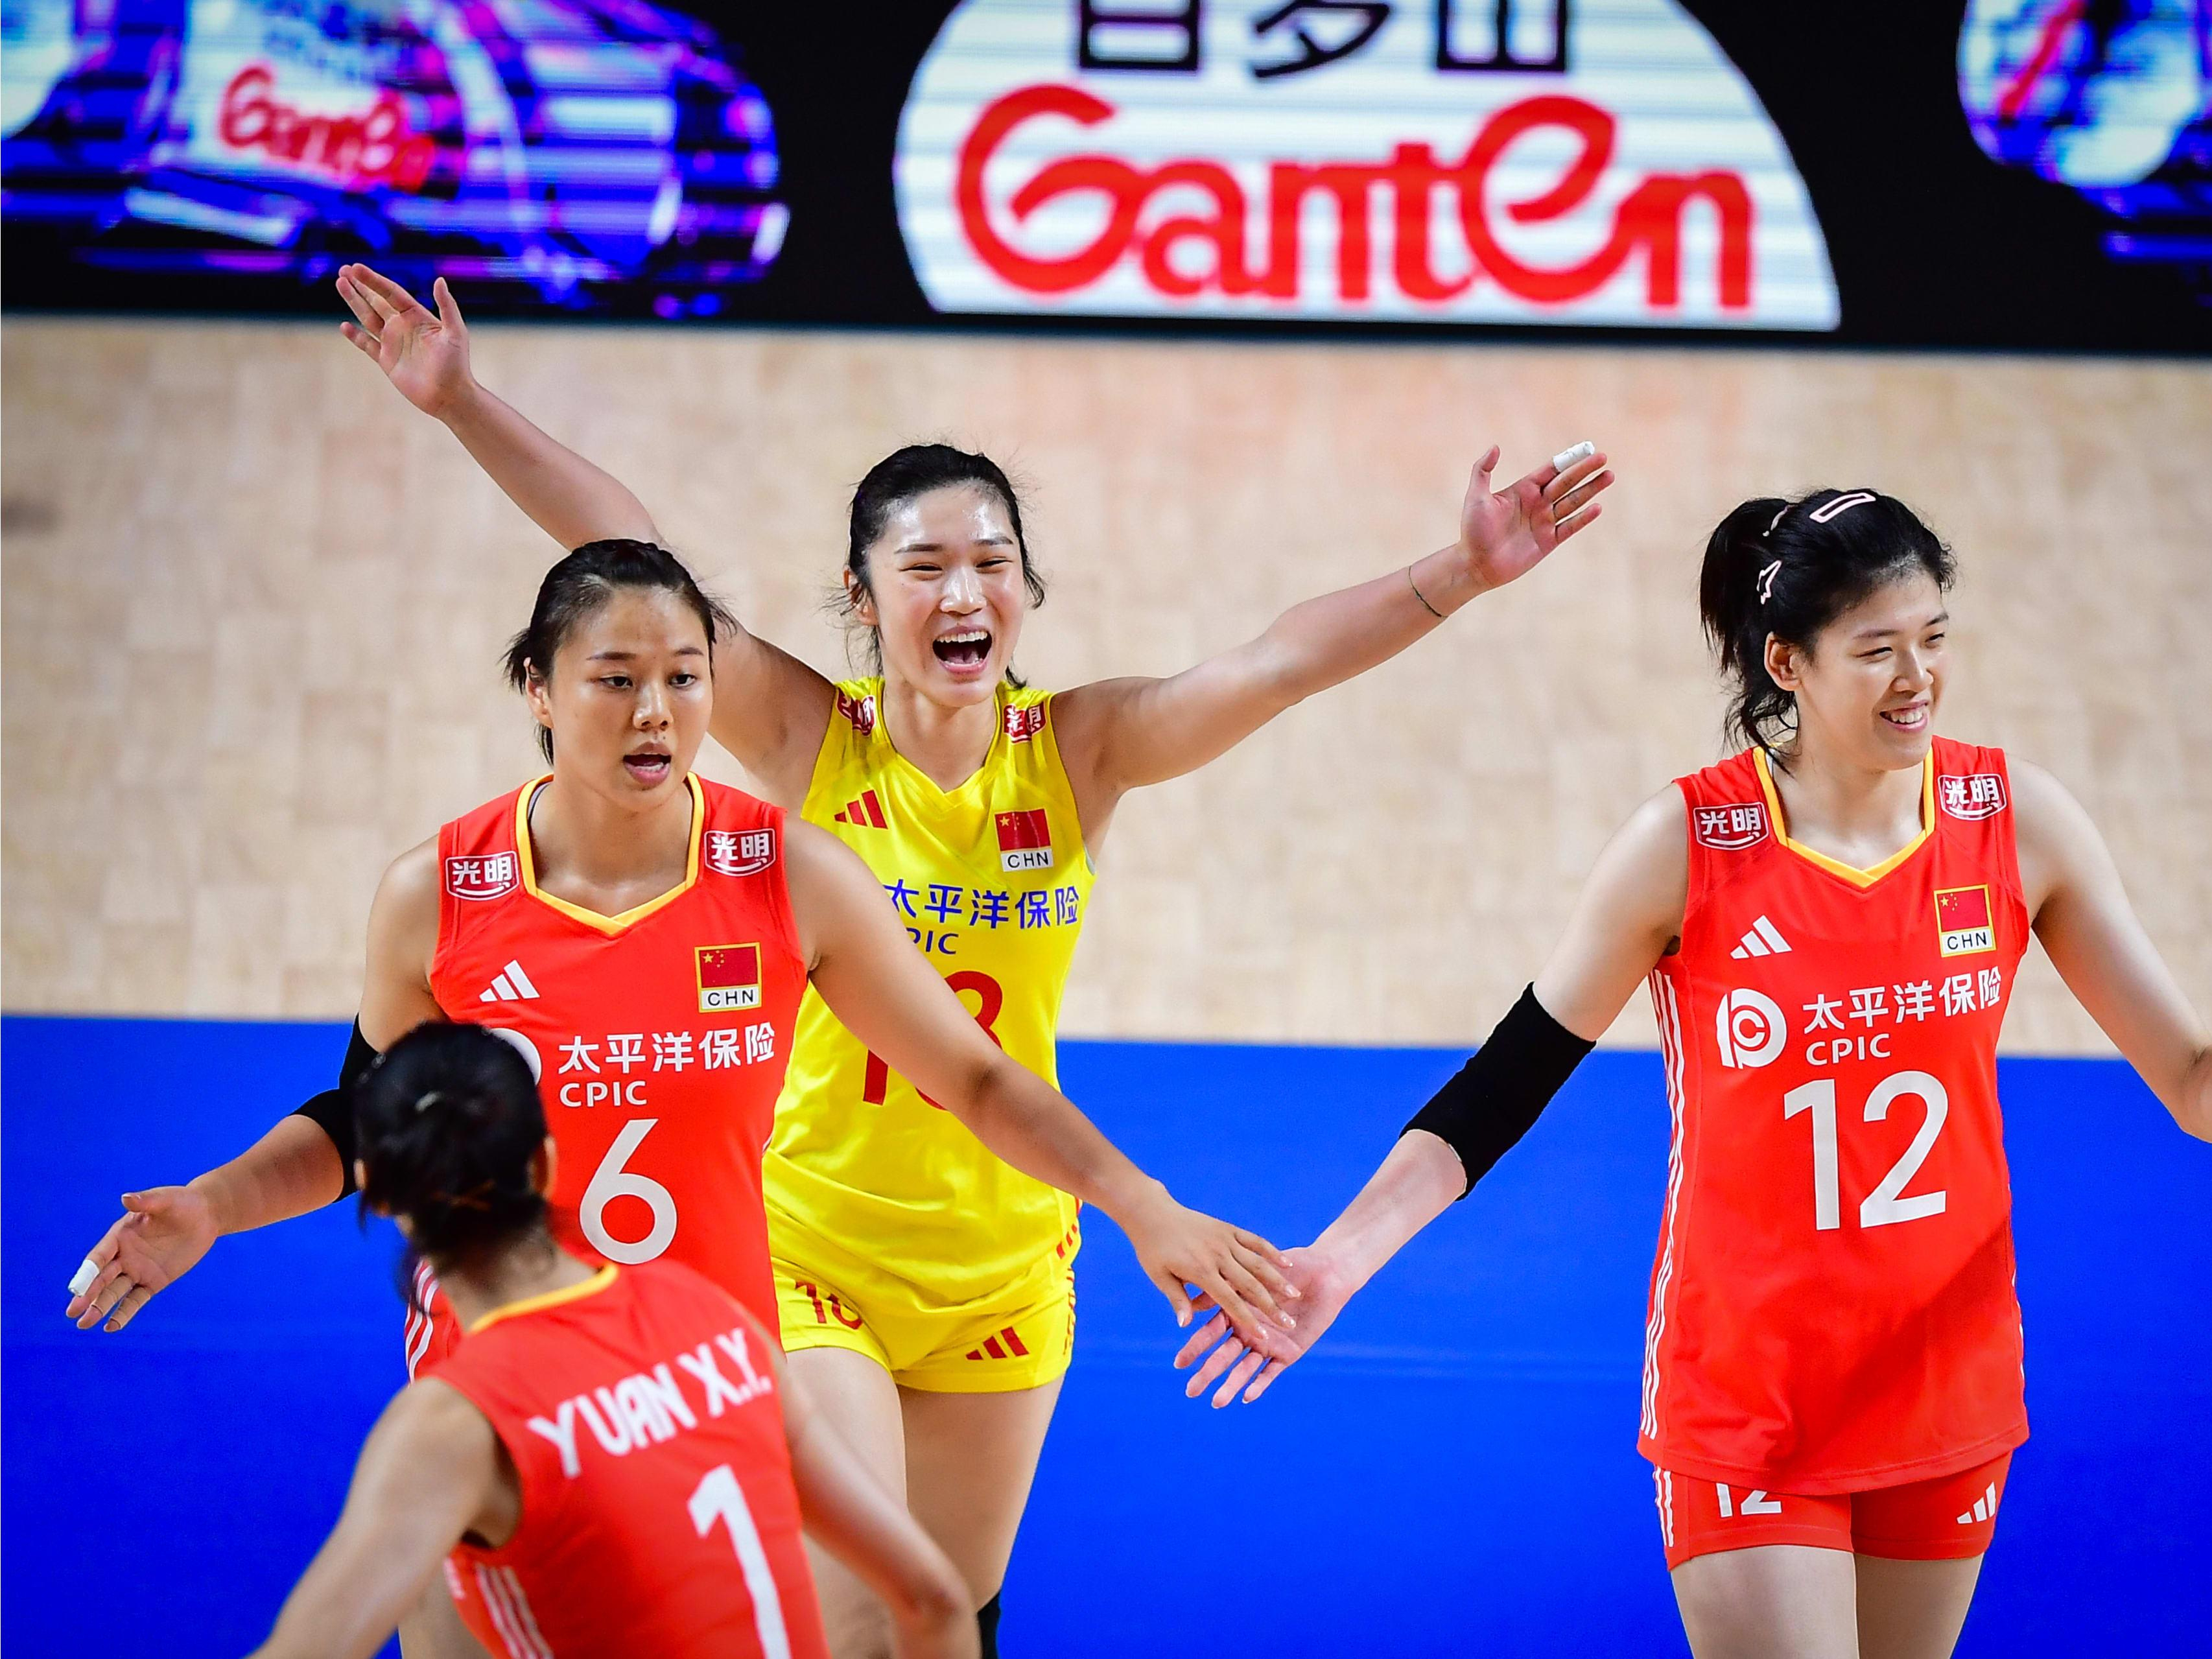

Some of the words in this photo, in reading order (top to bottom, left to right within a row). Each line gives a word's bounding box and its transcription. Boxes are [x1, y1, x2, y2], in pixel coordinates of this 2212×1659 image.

[1943, 777, 1999, 805] 光明
[1698, 805, 1761, 836] 光明
[711, 832, 770, 860] 光明
[1007, 851, 1049, 869] CHN
[452, 854, 513, 886] 光明
[1947, 931, 1987, 950] CHN
[707, 989, 754, 1007] CHN
[1802, 965, 2002, 1035] 太平洋保险
[558, 1022, 775, 1074] 太平洋保险
[1806, 1033, 1891, 1066] CPIC
[559, 1080, 648, 1107] CPIC
[1783, 1070, 1949, 1230] 12
[580, 1118, 677, 1265] 6
[527, 1363, 698, 1478] YUAN
[677, 1327, 772, 1418] X.Y.
[687, 1464, 792, 1659] 1
